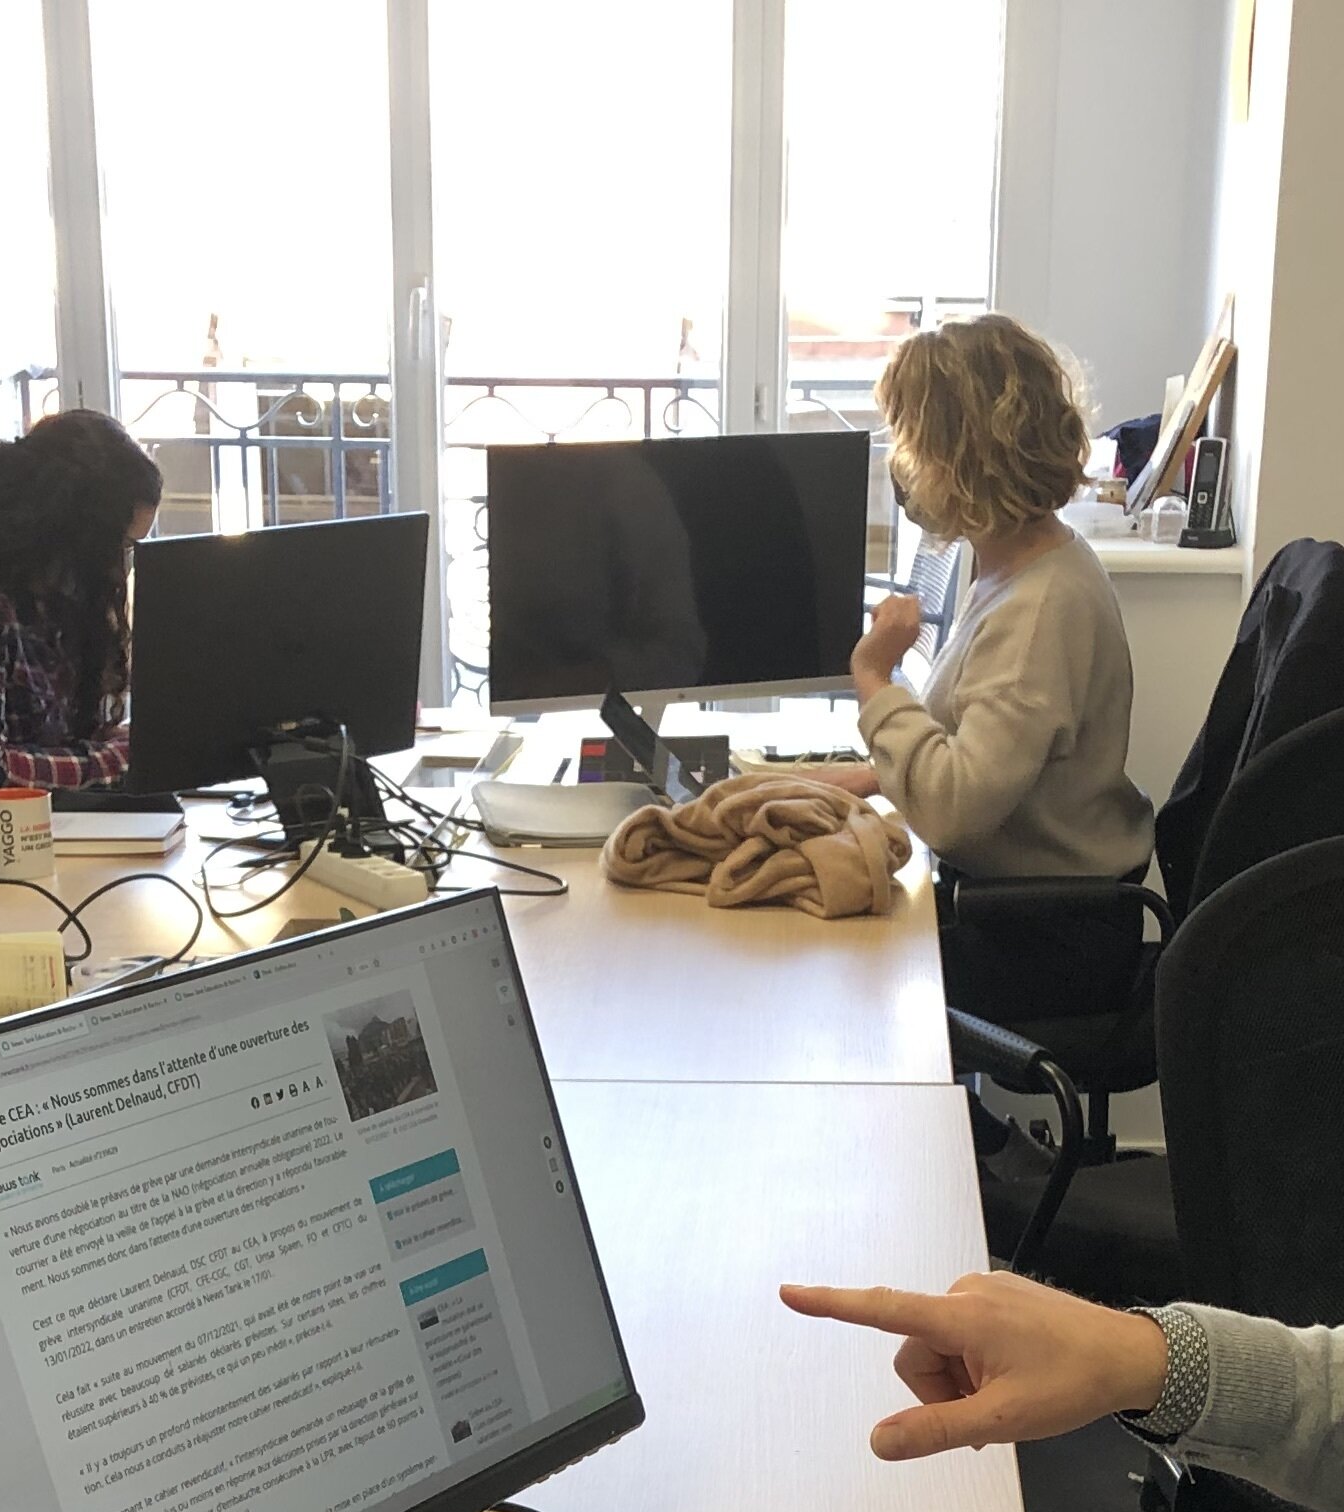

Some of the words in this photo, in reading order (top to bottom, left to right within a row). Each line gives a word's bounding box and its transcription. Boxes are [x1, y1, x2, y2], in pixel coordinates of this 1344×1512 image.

[0, 808, 16, 867] YAGGO
[7, 1102, 35, 1122] CEA
[49, 1090, 82, 1110] Nous
[82, 1075, 131, 1100] sommes
[131, 1066, 159, 1084] dans
[157, 1051, 207, 1076] l'attente
[207, 1042, 238, 1060] d'une
[238, 1026, 290, 1051] ouverture
[290, 1019, 310, 1035] des
[64, 1100, 116, 1130] (Laurent
[114, 1083, 167, 1112] Delnaud,
[166, 1072, 201, 1095] CFDT)
[16, 1169, 41, 1187] tank
[8, 1221, 34, 1237] Nous
[34, 1211, 60, 1229] avons
[59, 1199, 90, 1219] doublé
[98, 1187, 130, 1208] préavis
[140, 1175, 163, 1194] grève
[8, 1239, 41, 1258] verture
[128, 1201, 147, 1215] titre
[14, 1256, 49, 1276] courrier
[74, 1234, 105, 1255] envoyé
[114, 1224, 137, 1239] veille
[20, 1278, 46, 1295] ment.
[46, 1269, 71, 1285] Nous
[70, 1255, 107, 1277] sommes
[106, 1247, 128, 1263] donc
[127, 1240, 149, 1255] dans
[86, 1291, 118, 1310] déclare
[118, 1277, 152, 1298] Laurent
[93, 1332, 115, 1348] dans
[164, 1298, 196, 1320] accordé
[201, 1288, 224, 1304] News
[37, 1333, 63, 1353] grève
[126, 1293, 163, 1314] unanime
[54, 1389, 75, 1405] Cela
[75, 1382, 92, 1396] fait
[99, 1370, 121, 1387] suite
[60, 1401, 95, 1423] réussite
[98, 1391, 118, 1407] avec
[119, 1373, 161, 1397] beaucoup
[176, 1353, 207, 1373] salariés
[66, 1419, 98, 1441] étaient
[108, 1440, 145, 1463] toujours
[157, 1417, 191, 1444] profond
[83, 1480, 104, 1495] tion.
[103, 1470, 124, 1485] Cela
[122, 1460, 145, 1477] nous
[150, 1441, 186, 1464] conduits
[153, 1483, 178, 1503] cahier
[188, 1487, 214, 1506] moins
